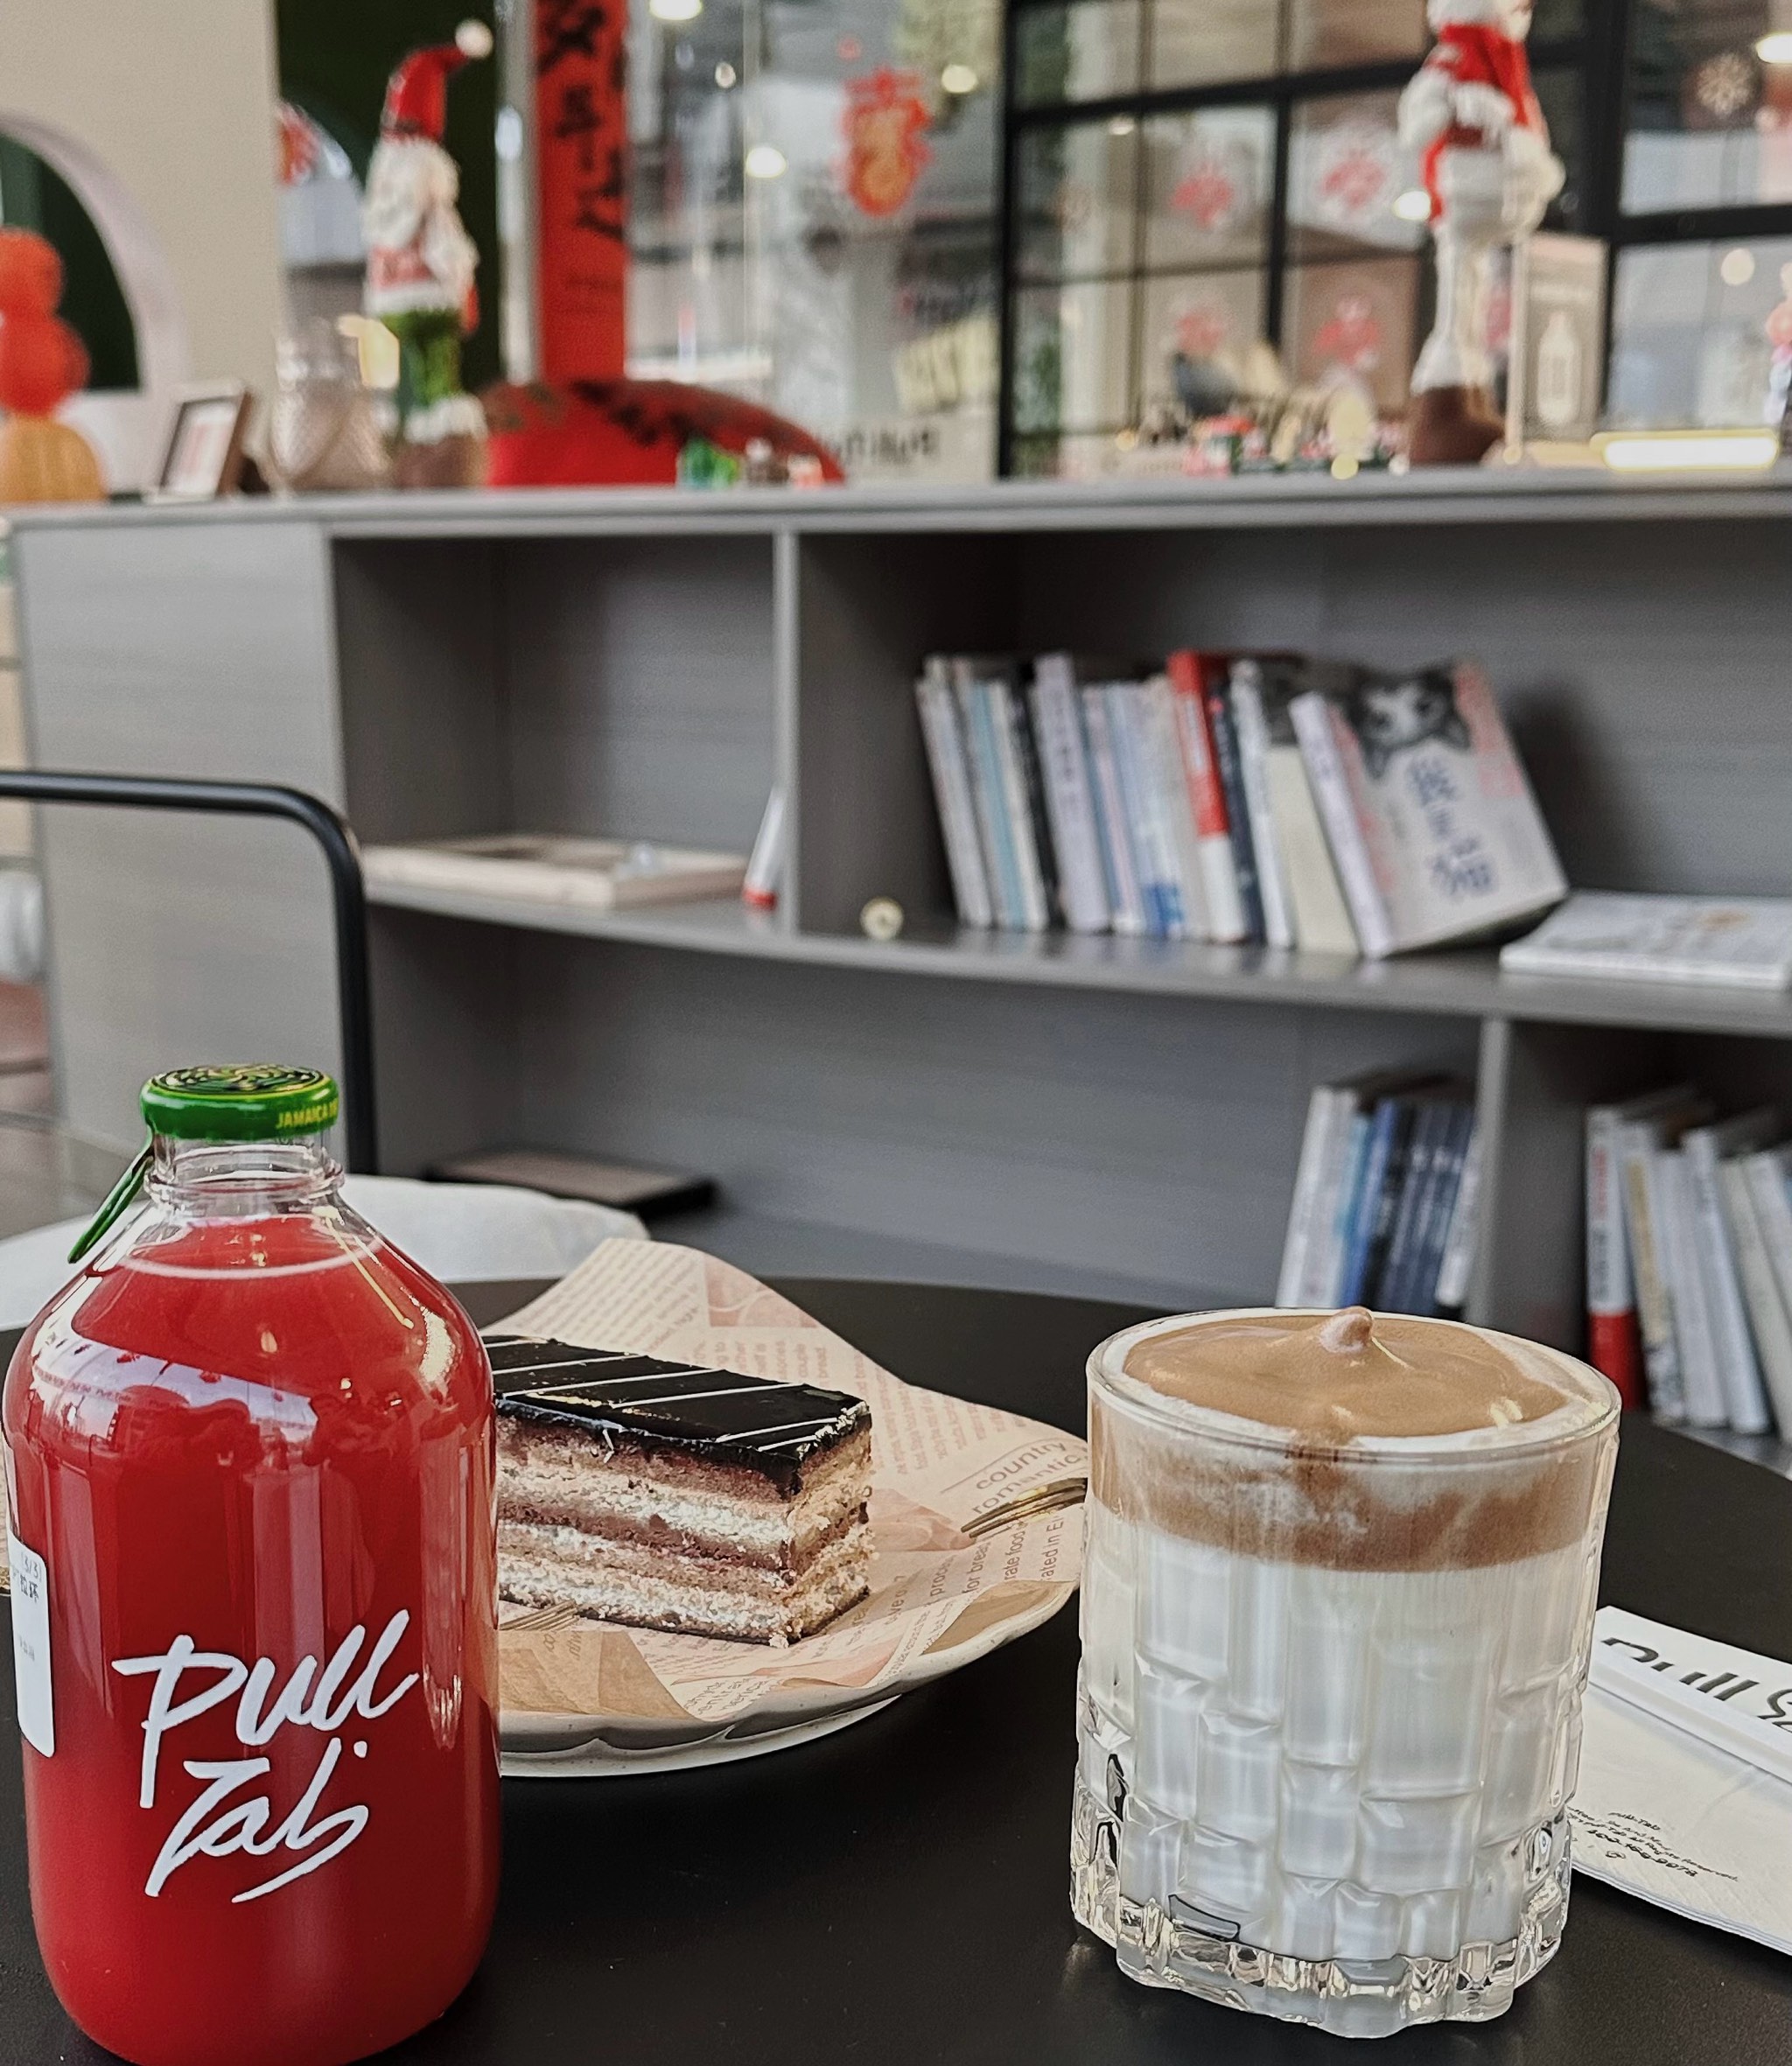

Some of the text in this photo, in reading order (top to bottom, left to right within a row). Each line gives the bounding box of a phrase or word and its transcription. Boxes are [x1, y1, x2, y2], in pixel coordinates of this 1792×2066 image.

[972, 1454, 1082, 1514] romantic
[976, 1443, 1066, 1489] country
[1039, 1548, 1058, 1580] ated
[111, 1609, 418, 1808] Pull
